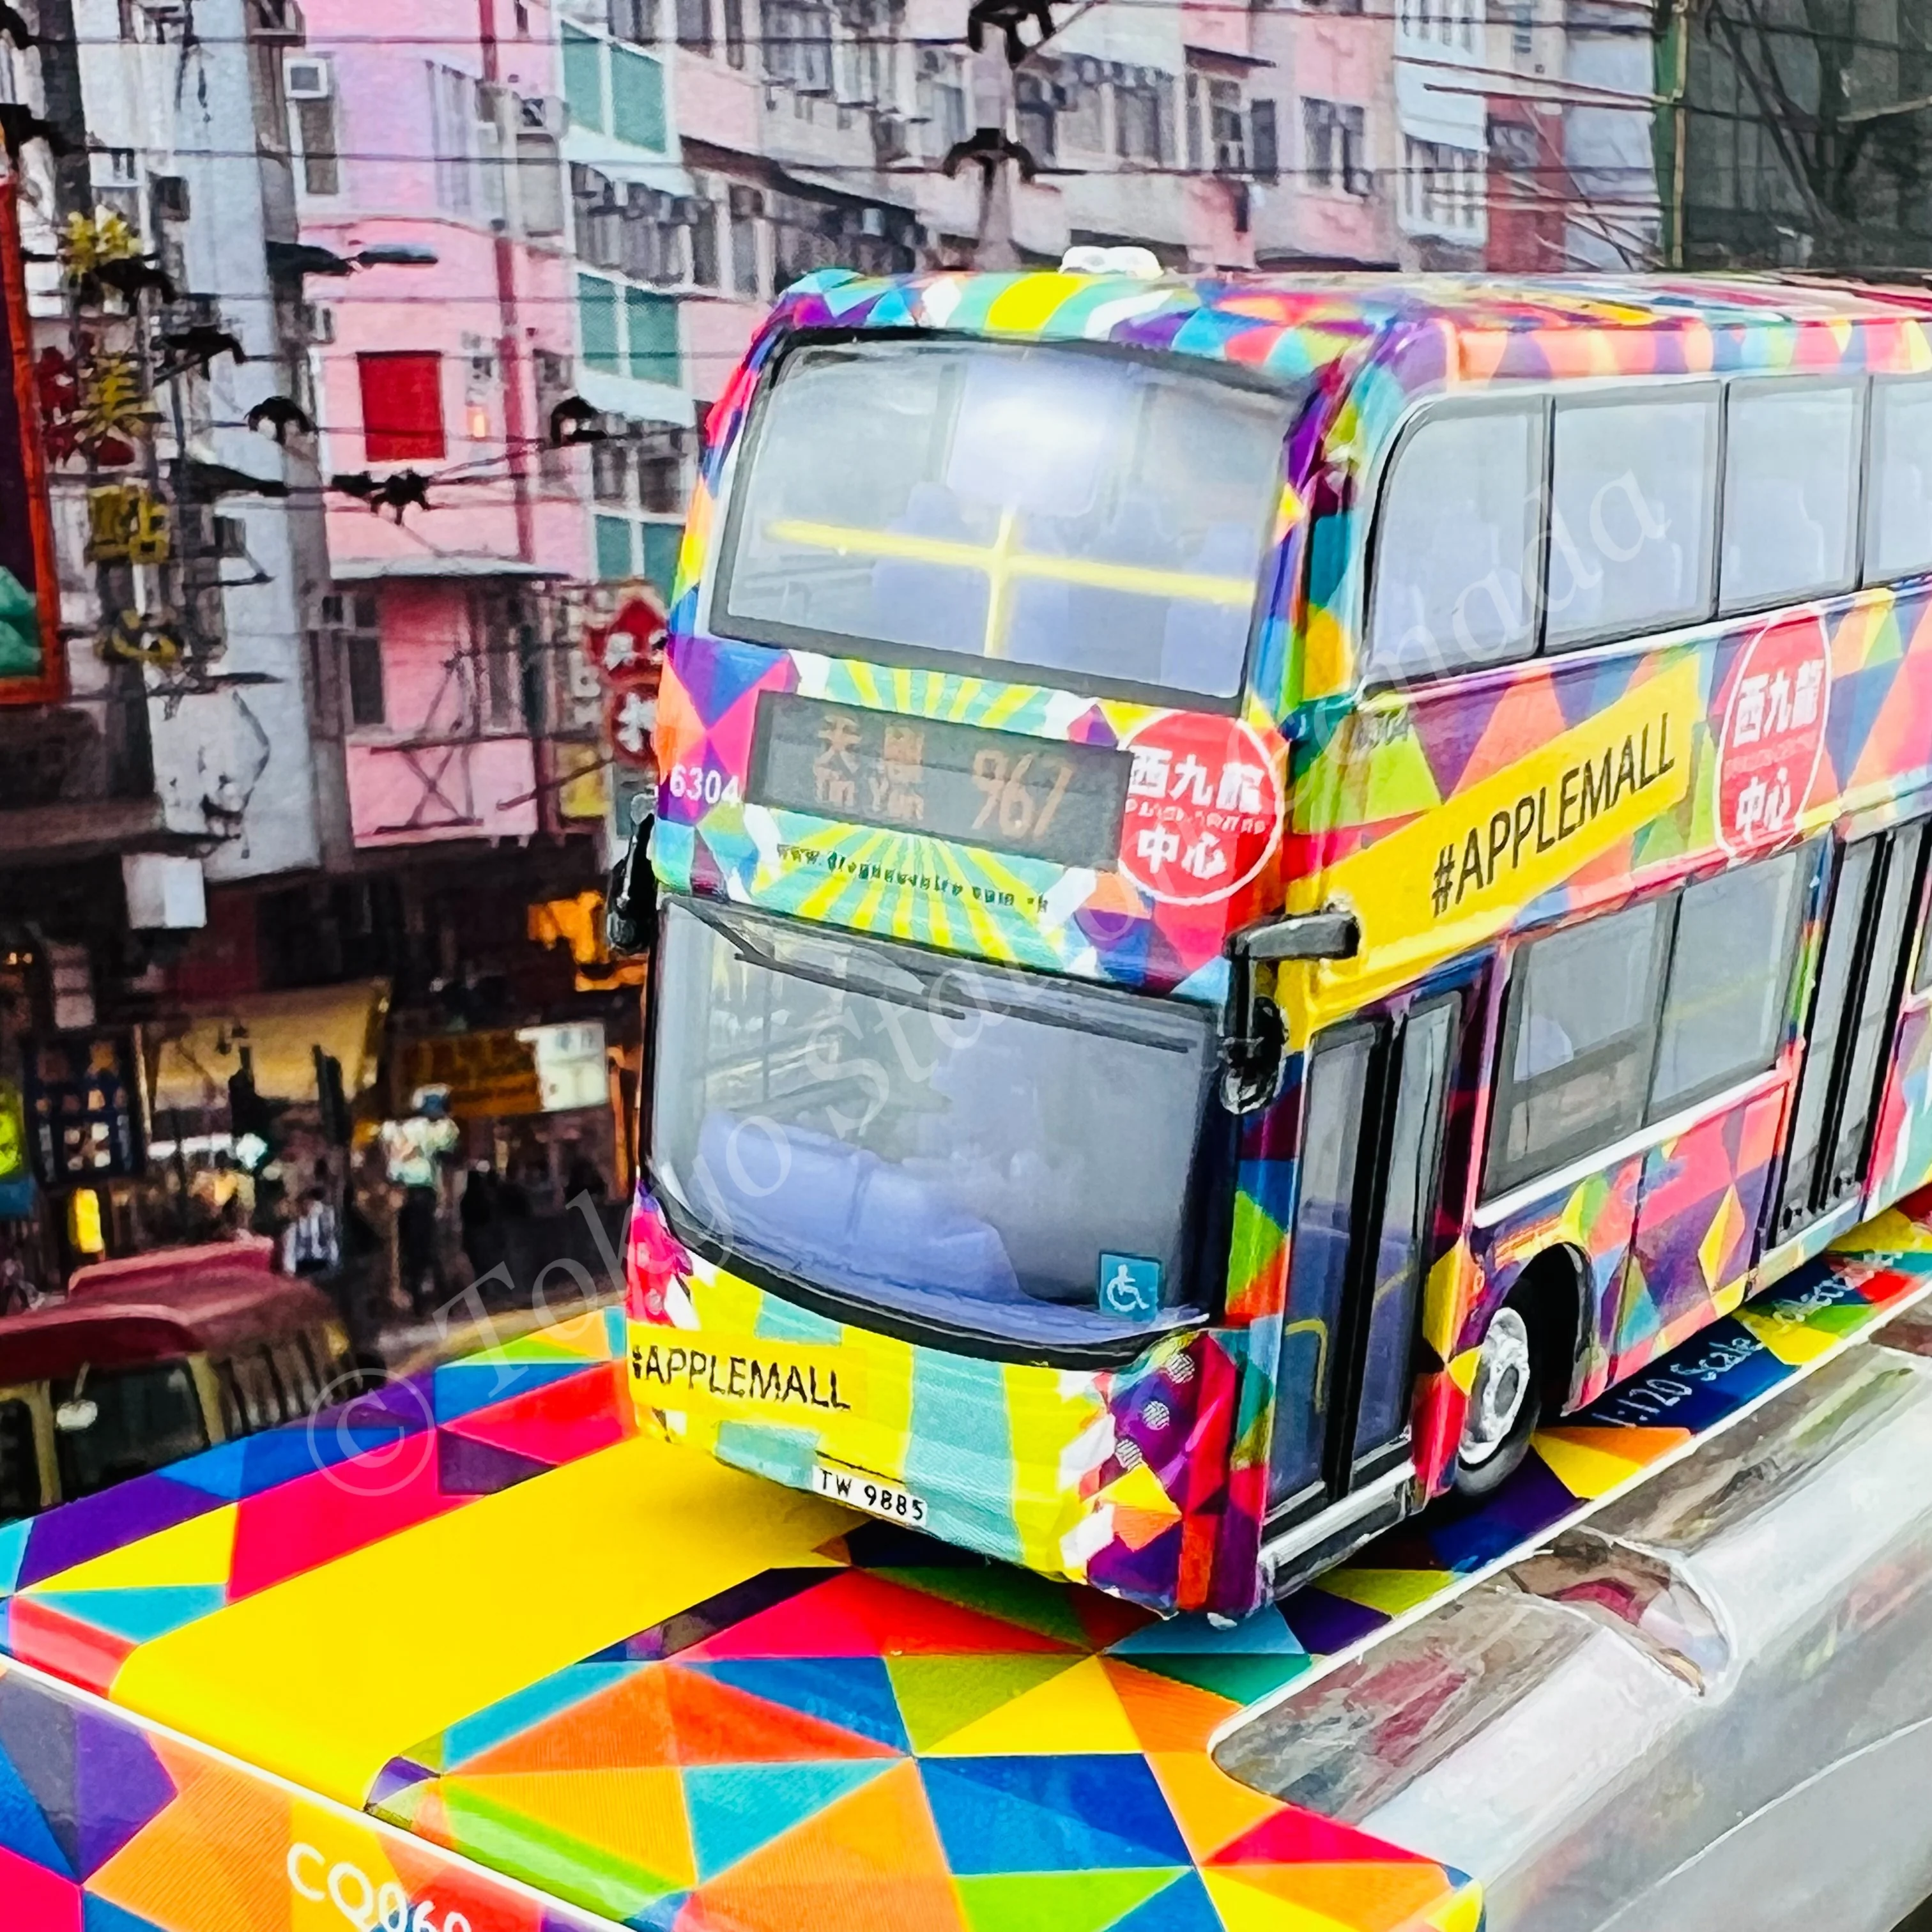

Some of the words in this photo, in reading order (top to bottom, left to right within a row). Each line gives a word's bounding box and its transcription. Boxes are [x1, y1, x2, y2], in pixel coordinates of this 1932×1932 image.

[670, 764, 741, 804] 6304
[970, 749, 1073, 838] 967
[1432, 712, 1675, 918] #APPLEMALL
[1735, 767, 1791, 844] 中心
[1137, 824, 1227, 880] 中心
[1591, 1378, 1693, 1428] 1:120
[1669, 1337, 1765, 1382] Scale
[817, 1469, 852, 1498] TW
[863, 1484, 924, 1522] 9885
